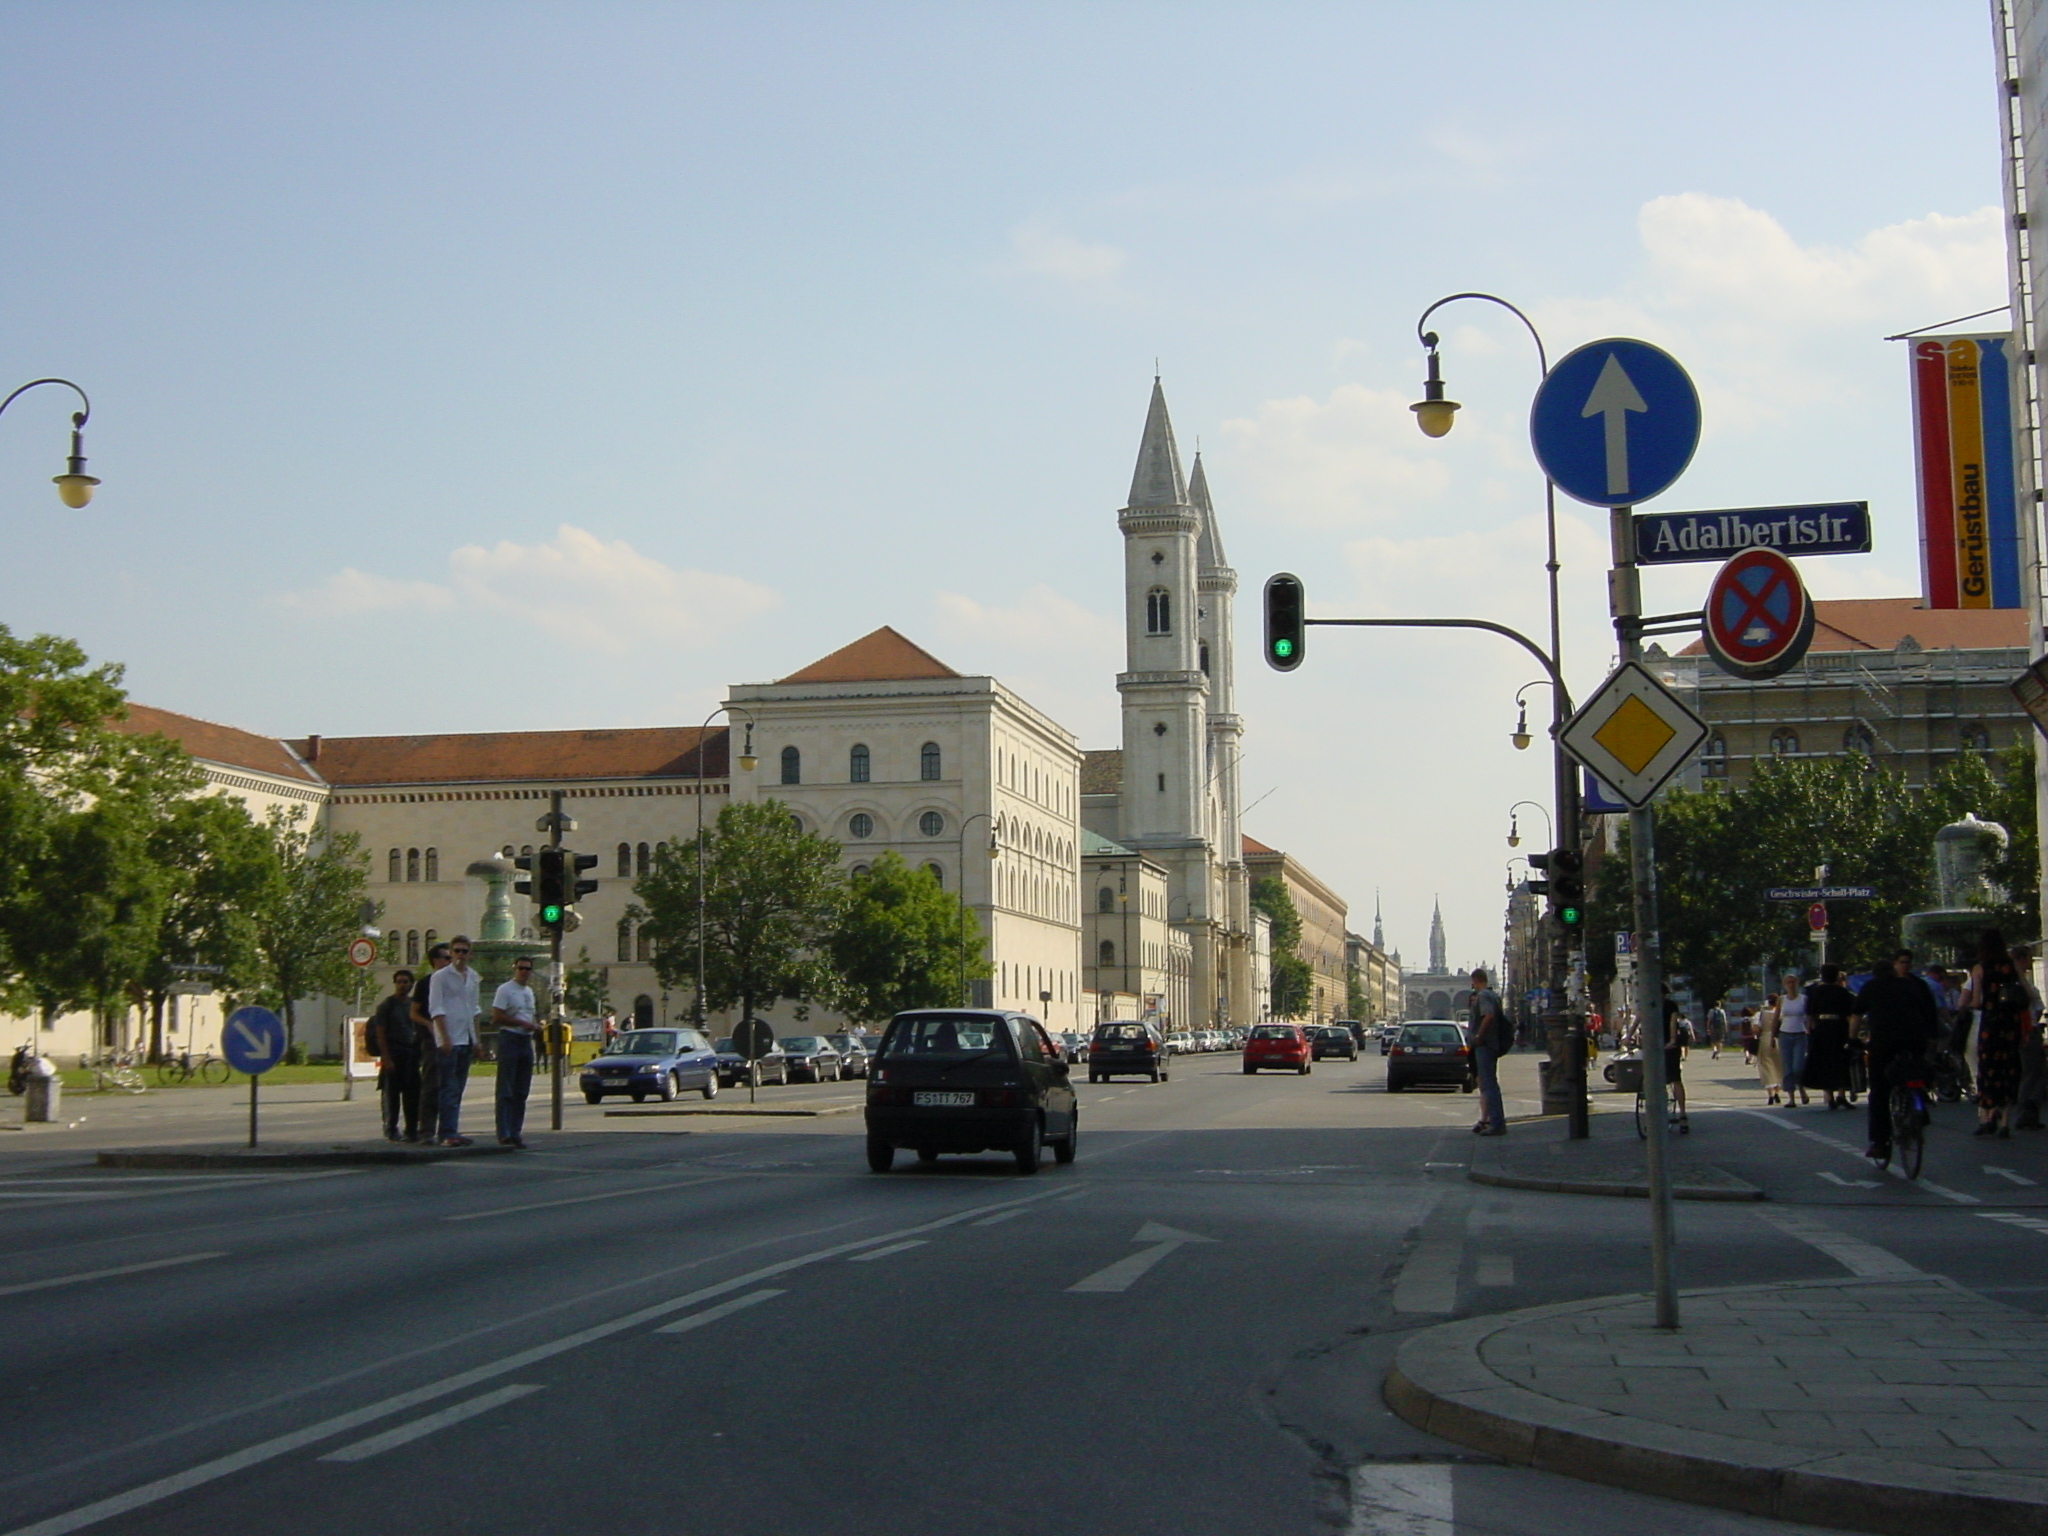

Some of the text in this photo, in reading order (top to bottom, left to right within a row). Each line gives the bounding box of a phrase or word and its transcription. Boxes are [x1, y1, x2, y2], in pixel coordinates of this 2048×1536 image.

[1653, 512, 1852, 553] Adalbertstr.
[1959, 464, 1986, 597] Gerüstbau
[1769, 887, 1872, 899] Geschwister-Scholl-Platz
[1616, 934, 1625, 952] P
[916, 1093, 931, 1104] FS
[953, 1093, 972, 1104] 767
